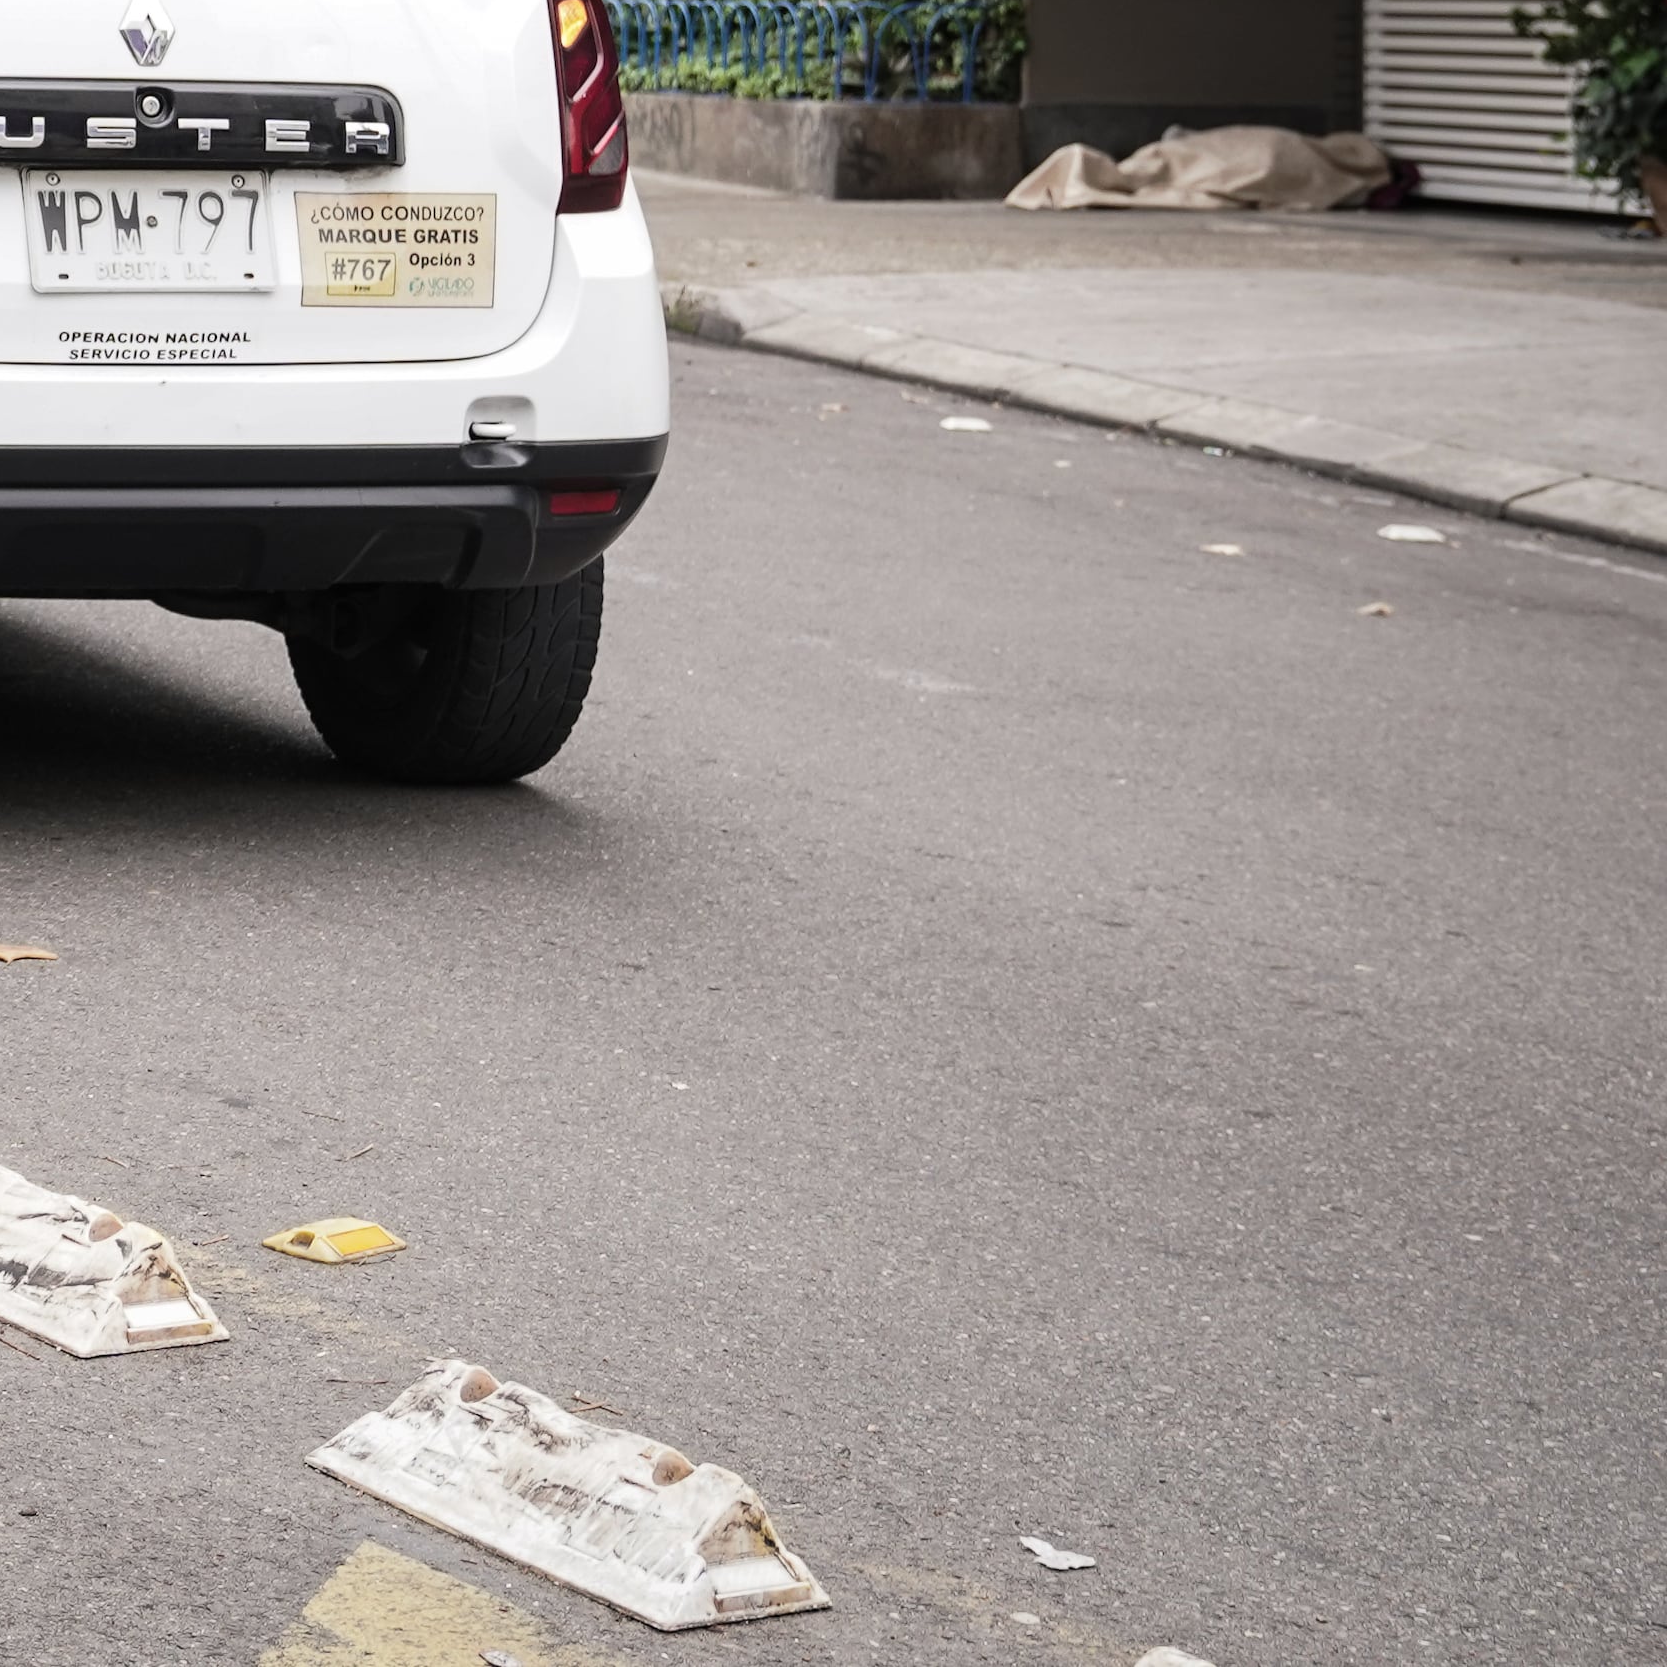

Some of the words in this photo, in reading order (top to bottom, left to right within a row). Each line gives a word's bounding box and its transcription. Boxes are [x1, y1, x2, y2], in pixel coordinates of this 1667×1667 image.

[310, 202, 374, 224] ¿CÓMO
[380, 206, 484, 222] CONDUZCO?
[318, 228, 407, 244] MARQUE
[413, 229, 479, 244] GRATIS
[409, 252, 462, 269] Opción
[467, 254, 476, 266] 3
[331, 257, 391, 281] #767
[58, 331, 160, 343] OPERACION
[166, 332, 252, 343] NACIONAL
[69, 348, 151, 360] SERVICIO
[157, 348, 238, 360] ESPECIAL
